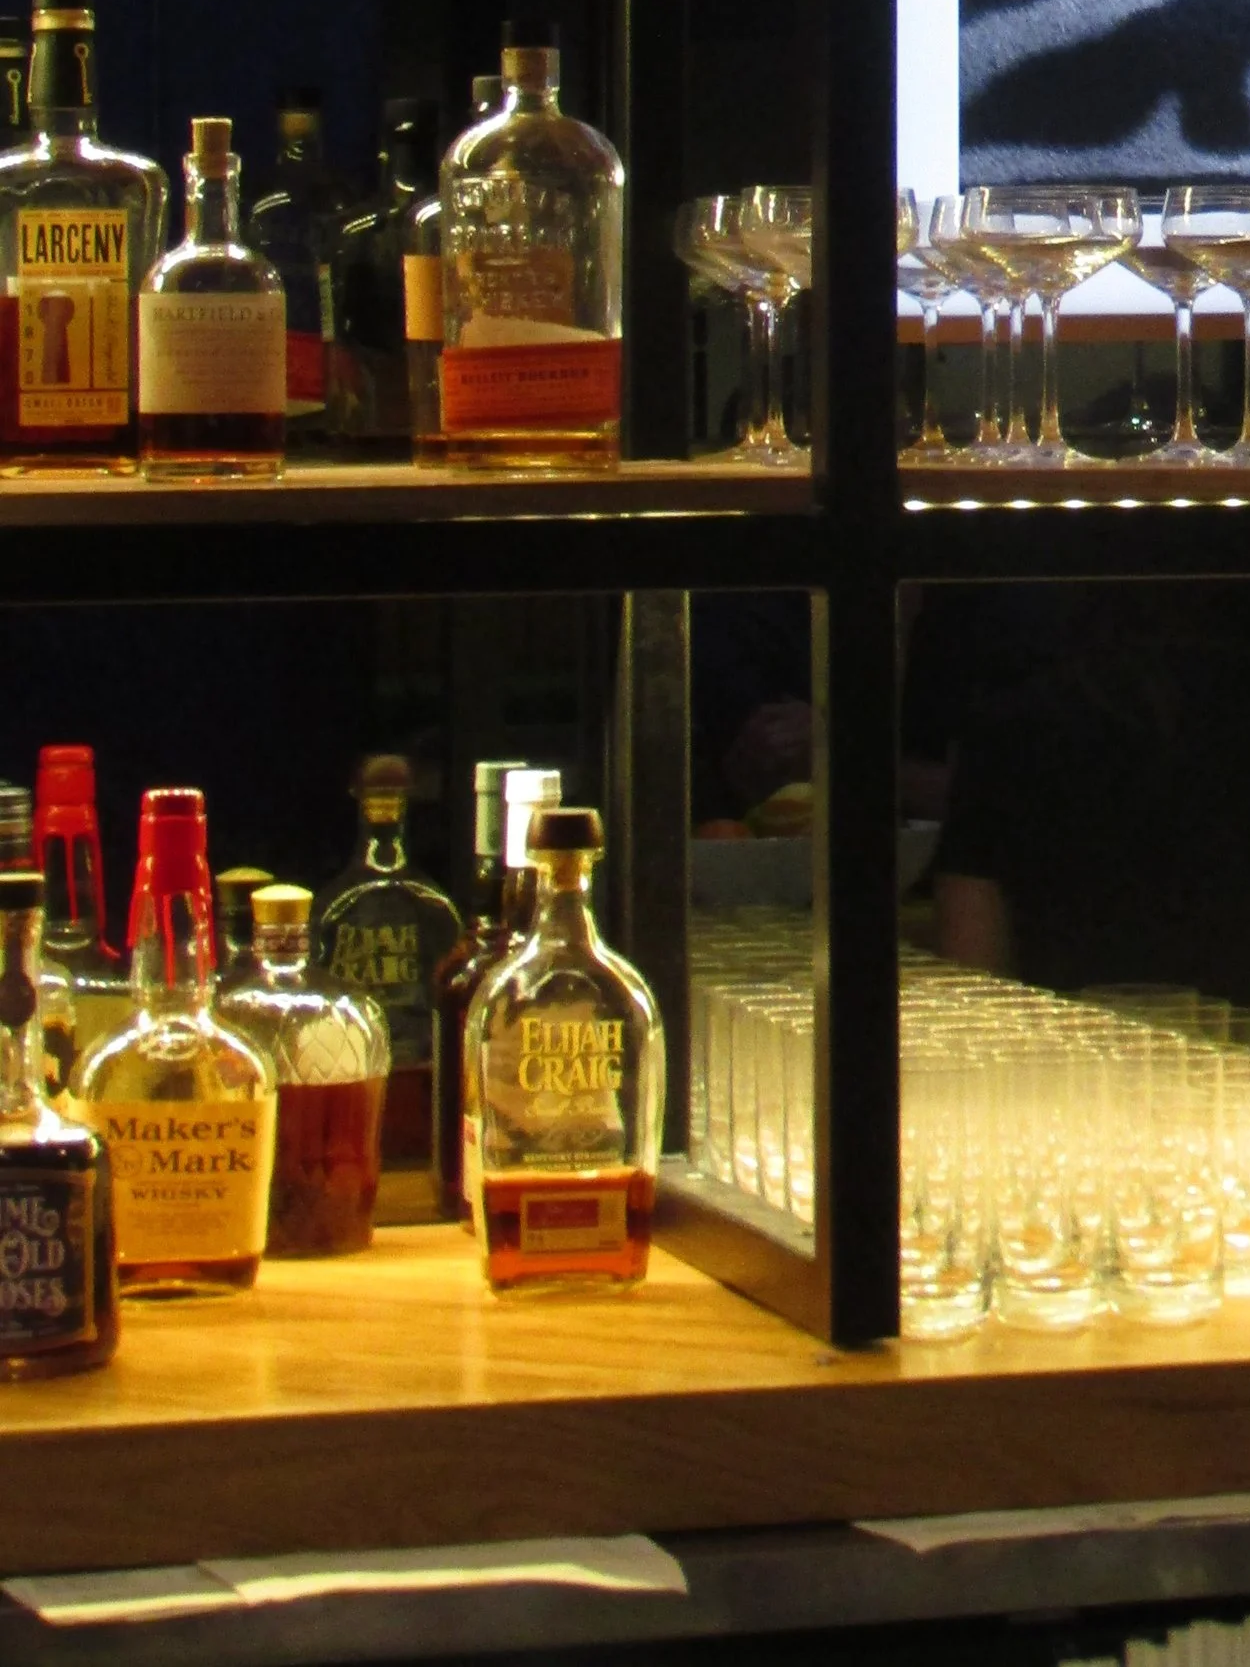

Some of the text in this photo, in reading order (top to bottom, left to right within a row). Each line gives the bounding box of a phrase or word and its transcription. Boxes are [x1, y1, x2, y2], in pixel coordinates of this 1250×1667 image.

[22, 223, 125, 264] LARCENY
[521, 1018, 624, 1056] ELIJAH
[518, 1054, 623, 1095] CRAIG
[107, 1117, 256, 1142] Maker's
[151, 1149, 255, 1174] Mark
[131, 1187, 227, 1200] WHISKY
